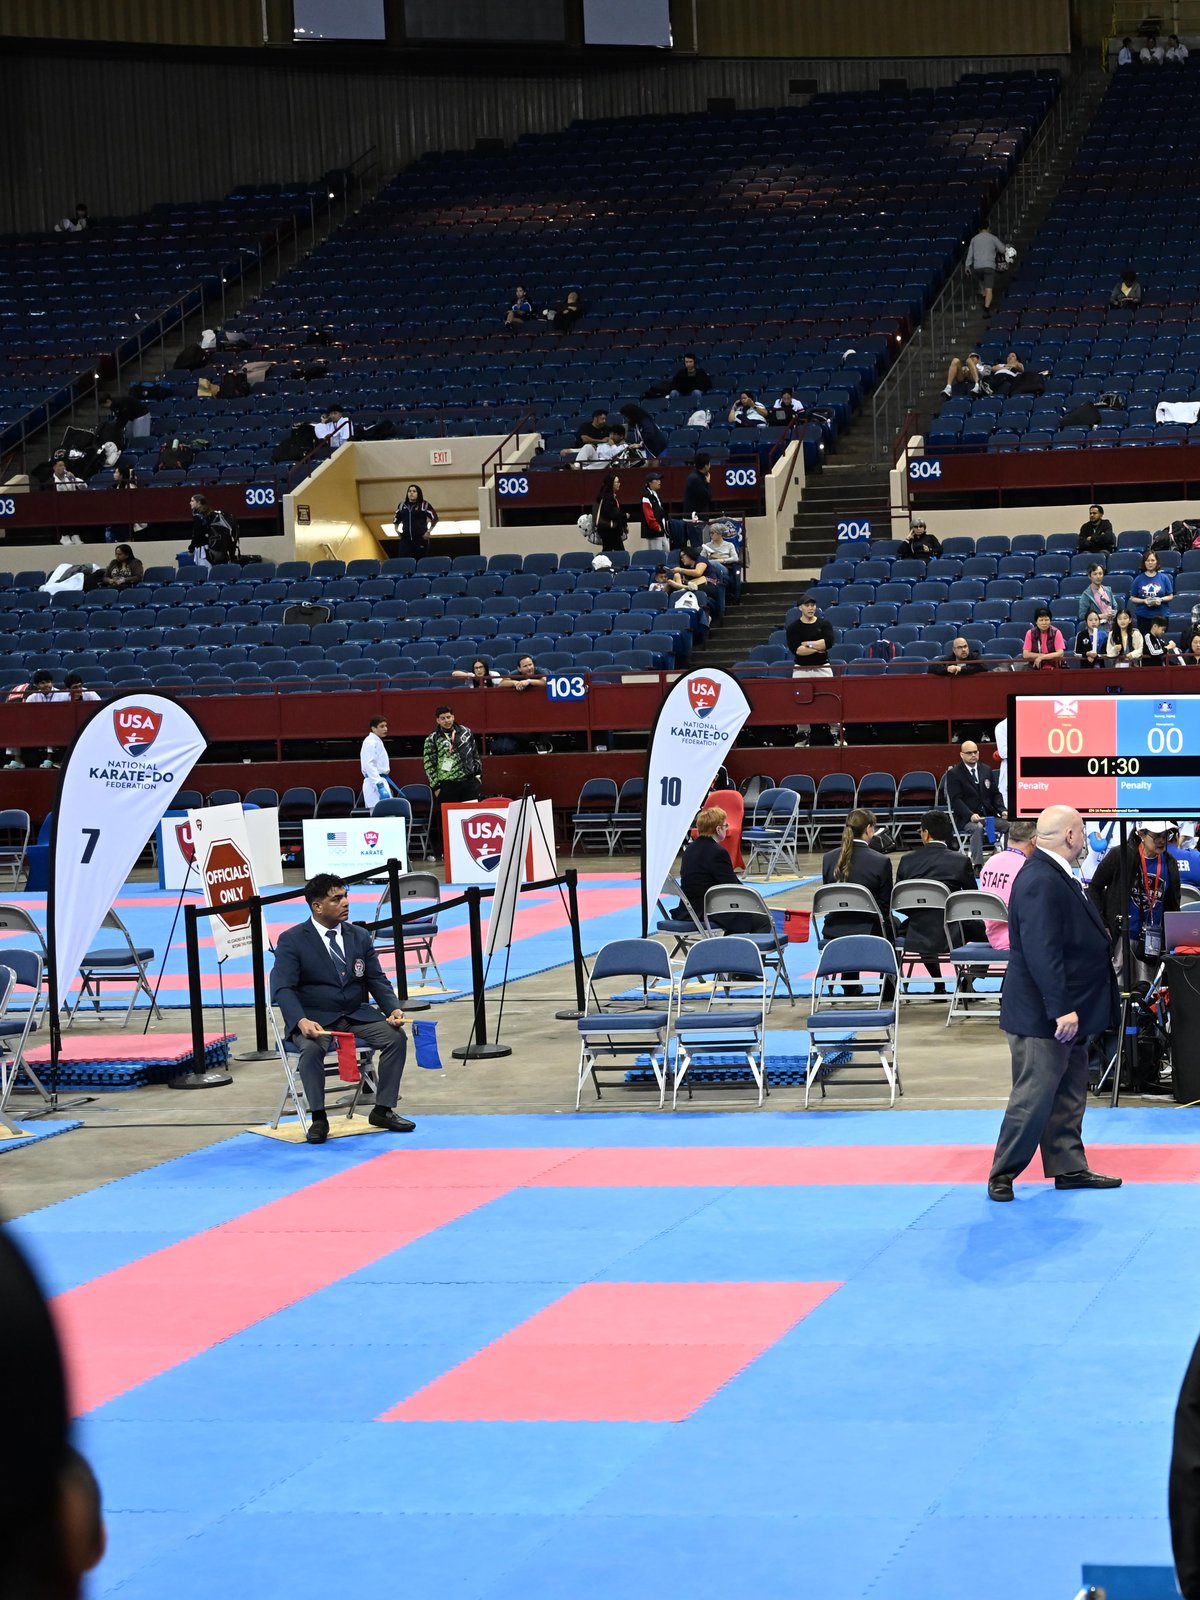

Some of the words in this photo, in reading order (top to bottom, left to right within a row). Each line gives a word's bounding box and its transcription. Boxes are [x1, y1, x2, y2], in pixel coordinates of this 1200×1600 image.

[433, 452, 448, 463] EXIT
[725, 469, 757, 486] 303
[909, 461, 942, 479] 304
[498, 477, 529, 494] 303
[245, 488, 275, 505] 303
[0, 499, 15, 515] 03
[837, 522, 871, 540] 204
[547, 677, 586, 697] 103
[691, 682, 716, 697] USA
[119, 713, 155, 730] USA
[683, 721, 718, 730] NATIONAL
[670, 727, 729, 741] KARATE-DO
[681, 738, 717, 746] FEDERATION
[1048, 728, 1083, 754] 00
[1147, 727, 1183, 753] 00
[107, 760, 158, 771] NATIONAL
[1087, 757, 1140, 775] 01:30
[89, 767, 174, 783] KARATE-DO
[106, 781, 157, 790] FEDERATION
[660, 776, 682, 807] 10
[1018, 782, 1049, 791] Penalty
[1120, 781, 1152, 791] Penalty
[468, 822, 505, 839] USA
[80, 828, 101, 864] 7
[206, 865, 250, 885] OFFICIALS
[982, 871, 1010, 889] STAFF
[219, 886, 244, 904] ONLY
